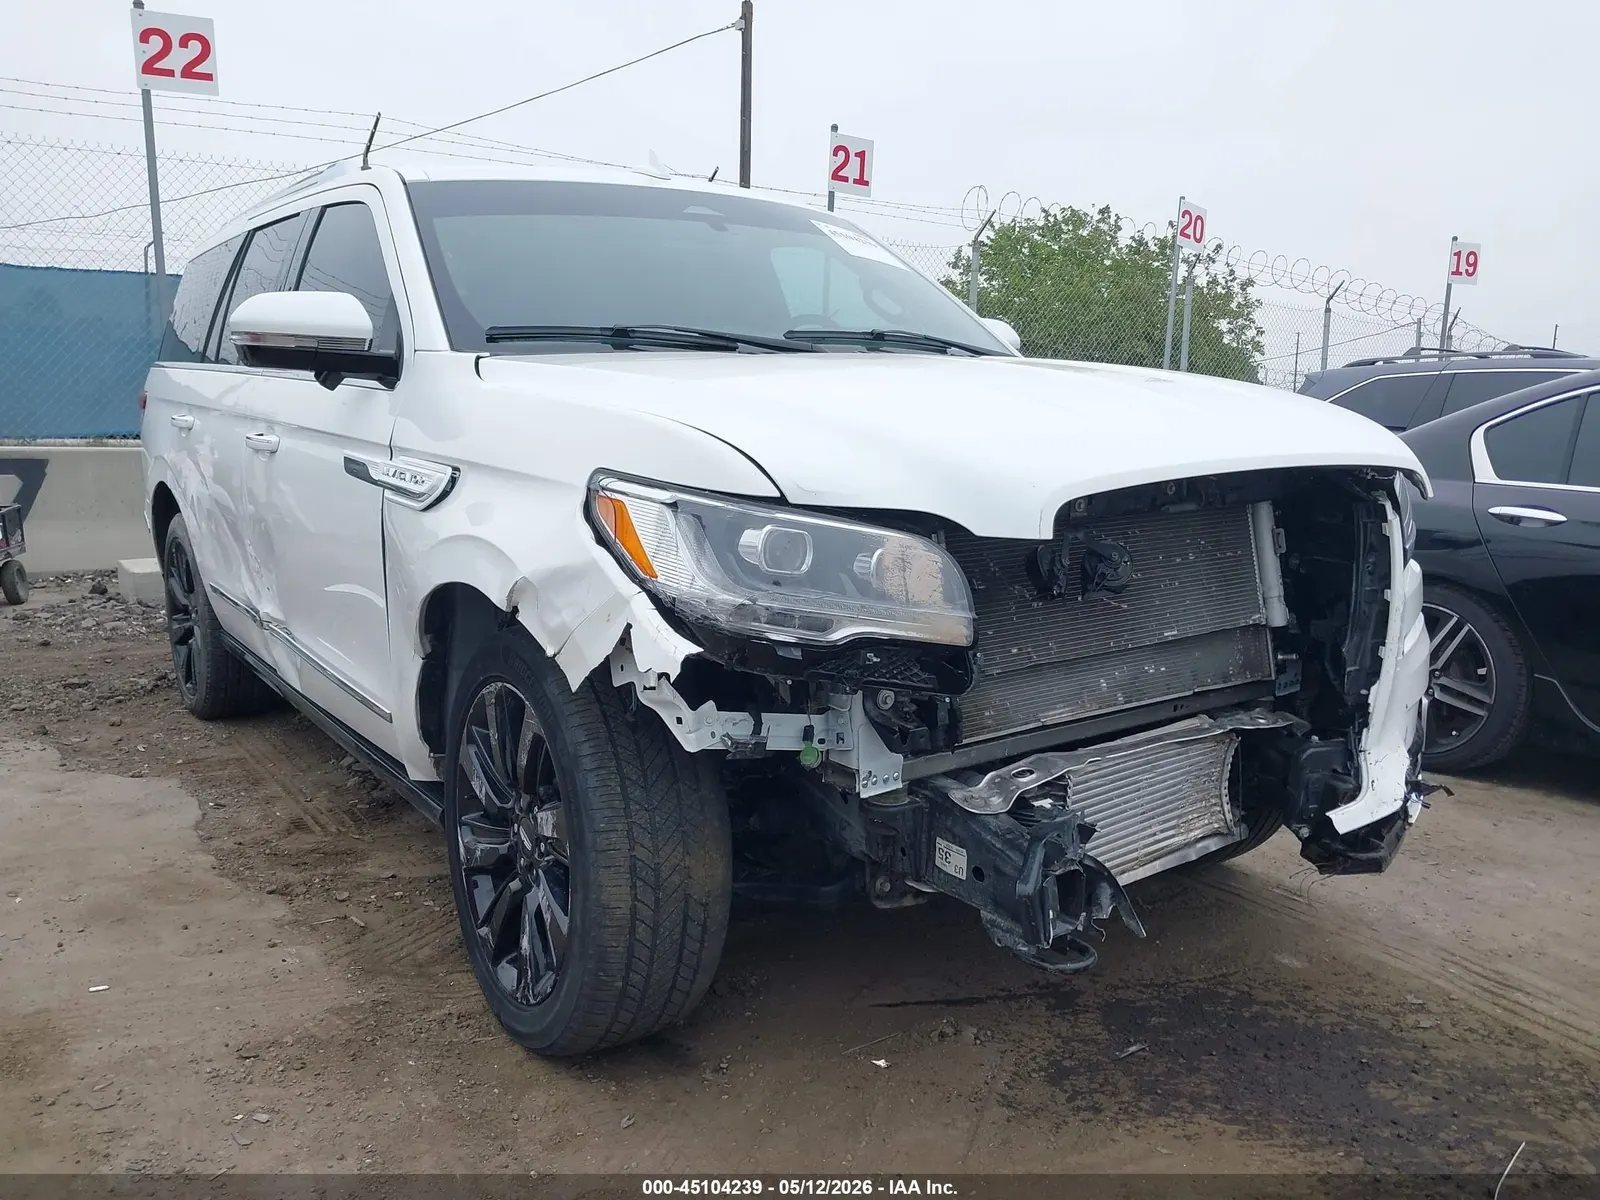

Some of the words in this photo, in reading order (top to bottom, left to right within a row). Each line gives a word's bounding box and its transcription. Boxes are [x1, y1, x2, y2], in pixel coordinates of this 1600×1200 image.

[139, 27, 213, 82] 22
[830, 145, 870, 187] 21
[1179, 209, 1205, 243] 20
[1451, 251, 1479, 277] 19
[938, 847, 952, 865] 35
[953, 864, 964, 877] U3
